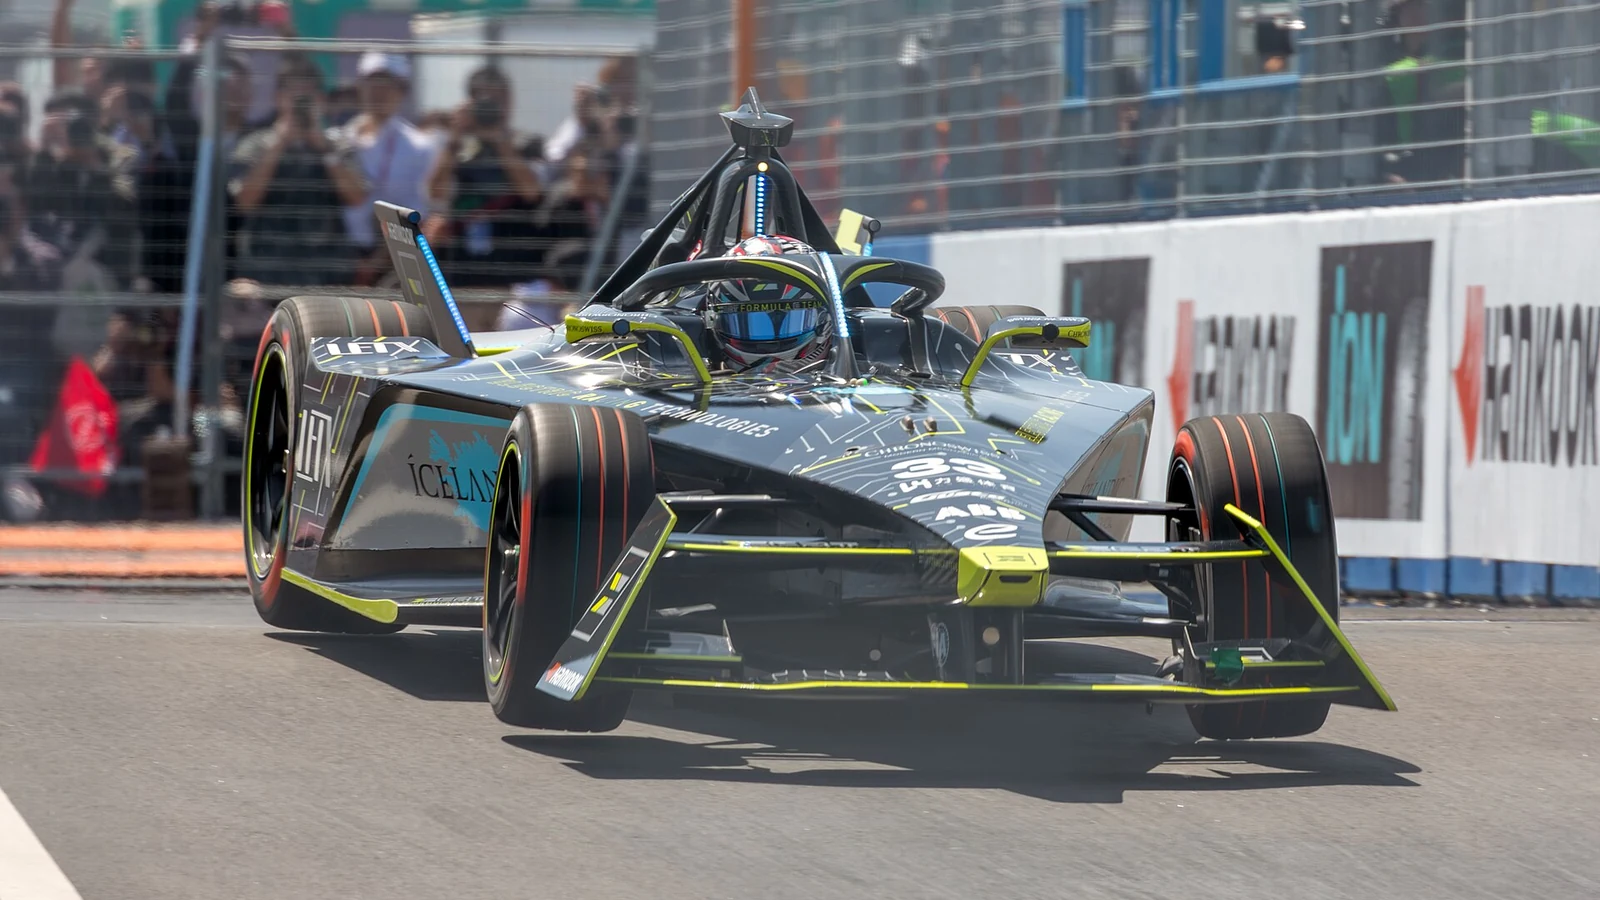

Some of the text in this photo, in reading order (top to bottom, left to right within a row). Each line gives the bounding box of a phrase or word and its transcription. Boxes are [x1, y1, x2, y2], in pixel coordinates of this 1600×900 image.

[740, 302, 792, 313] FORMULA
[640, 402, 779, 438] TECHNOLOGIES
[407, 453, 498, 503] ÍCELAN
[891, 457, 1007, 480] 33
